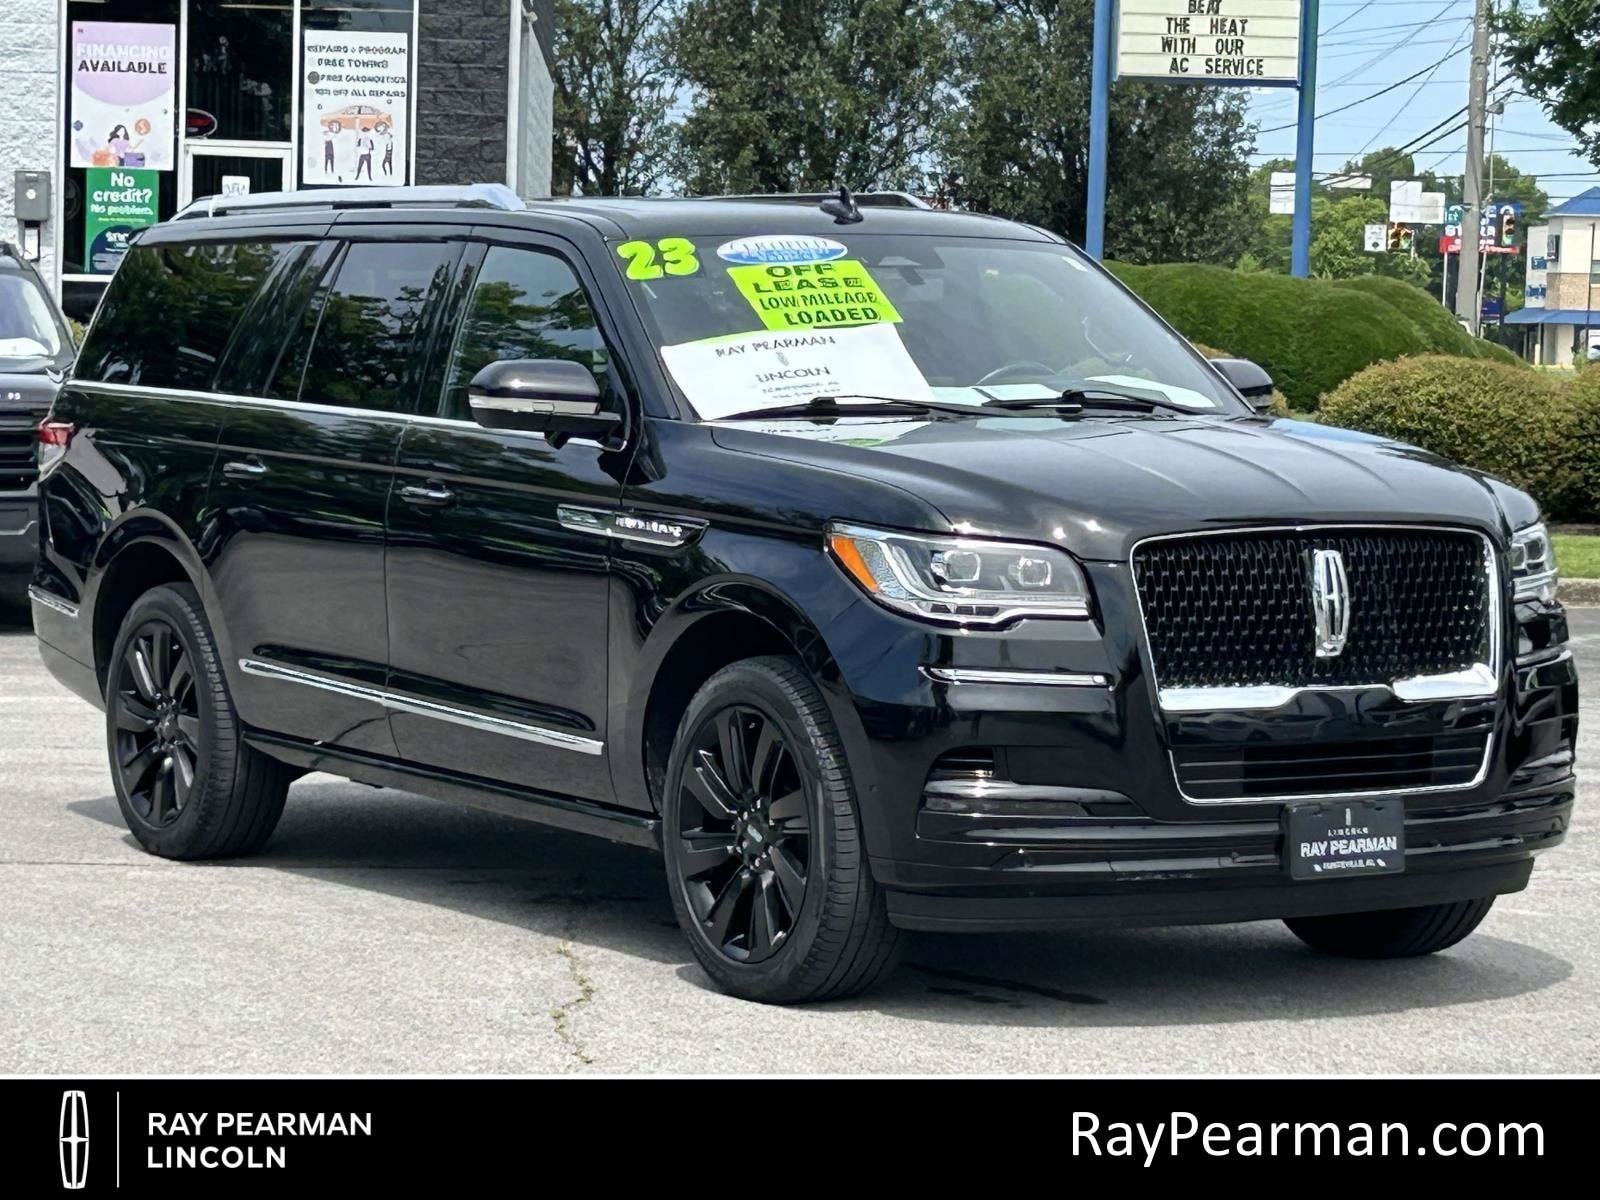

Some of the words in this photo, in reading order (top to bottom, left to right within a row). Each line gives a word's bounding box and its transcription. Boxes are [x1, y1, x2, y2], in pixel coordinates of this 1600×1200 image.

[1188, 0, 1222, 15] BEAT
[1166, 17, 1190, 35] THE
[1209, 17, 1248, 36] HEAT
[76, 43, 170, 59] FINANCING
[1161, 36, 1196, 54] WITH
[1215, 38, 1244, 55] OUR
[78, 59, 167, 74] AVAILABLE
[1169, 57, 1189, 74] AC
[1205, 58, 1264, 76] SERVICE
[110, 172, 135, 187] No
[93, 188, 152, 203] credit?
[90, 204, 106, 213] No
[617, 238, 699, 280] 23
[766, 263, 835, 278] OFF
[759, 296, 799, 310] LOW
[801, 291, 878, 308] MILEAGE
[783, 307, 881, 325] LOADED
[715, 345, 745, 357] RAY
[751, 336, 836, 351] PEARMAN
[755, 366, 831, 383] LINCOLN
[1300, 841, 1328, 857] RAY
[1329, 836, 1398, 855] PEARMAN
